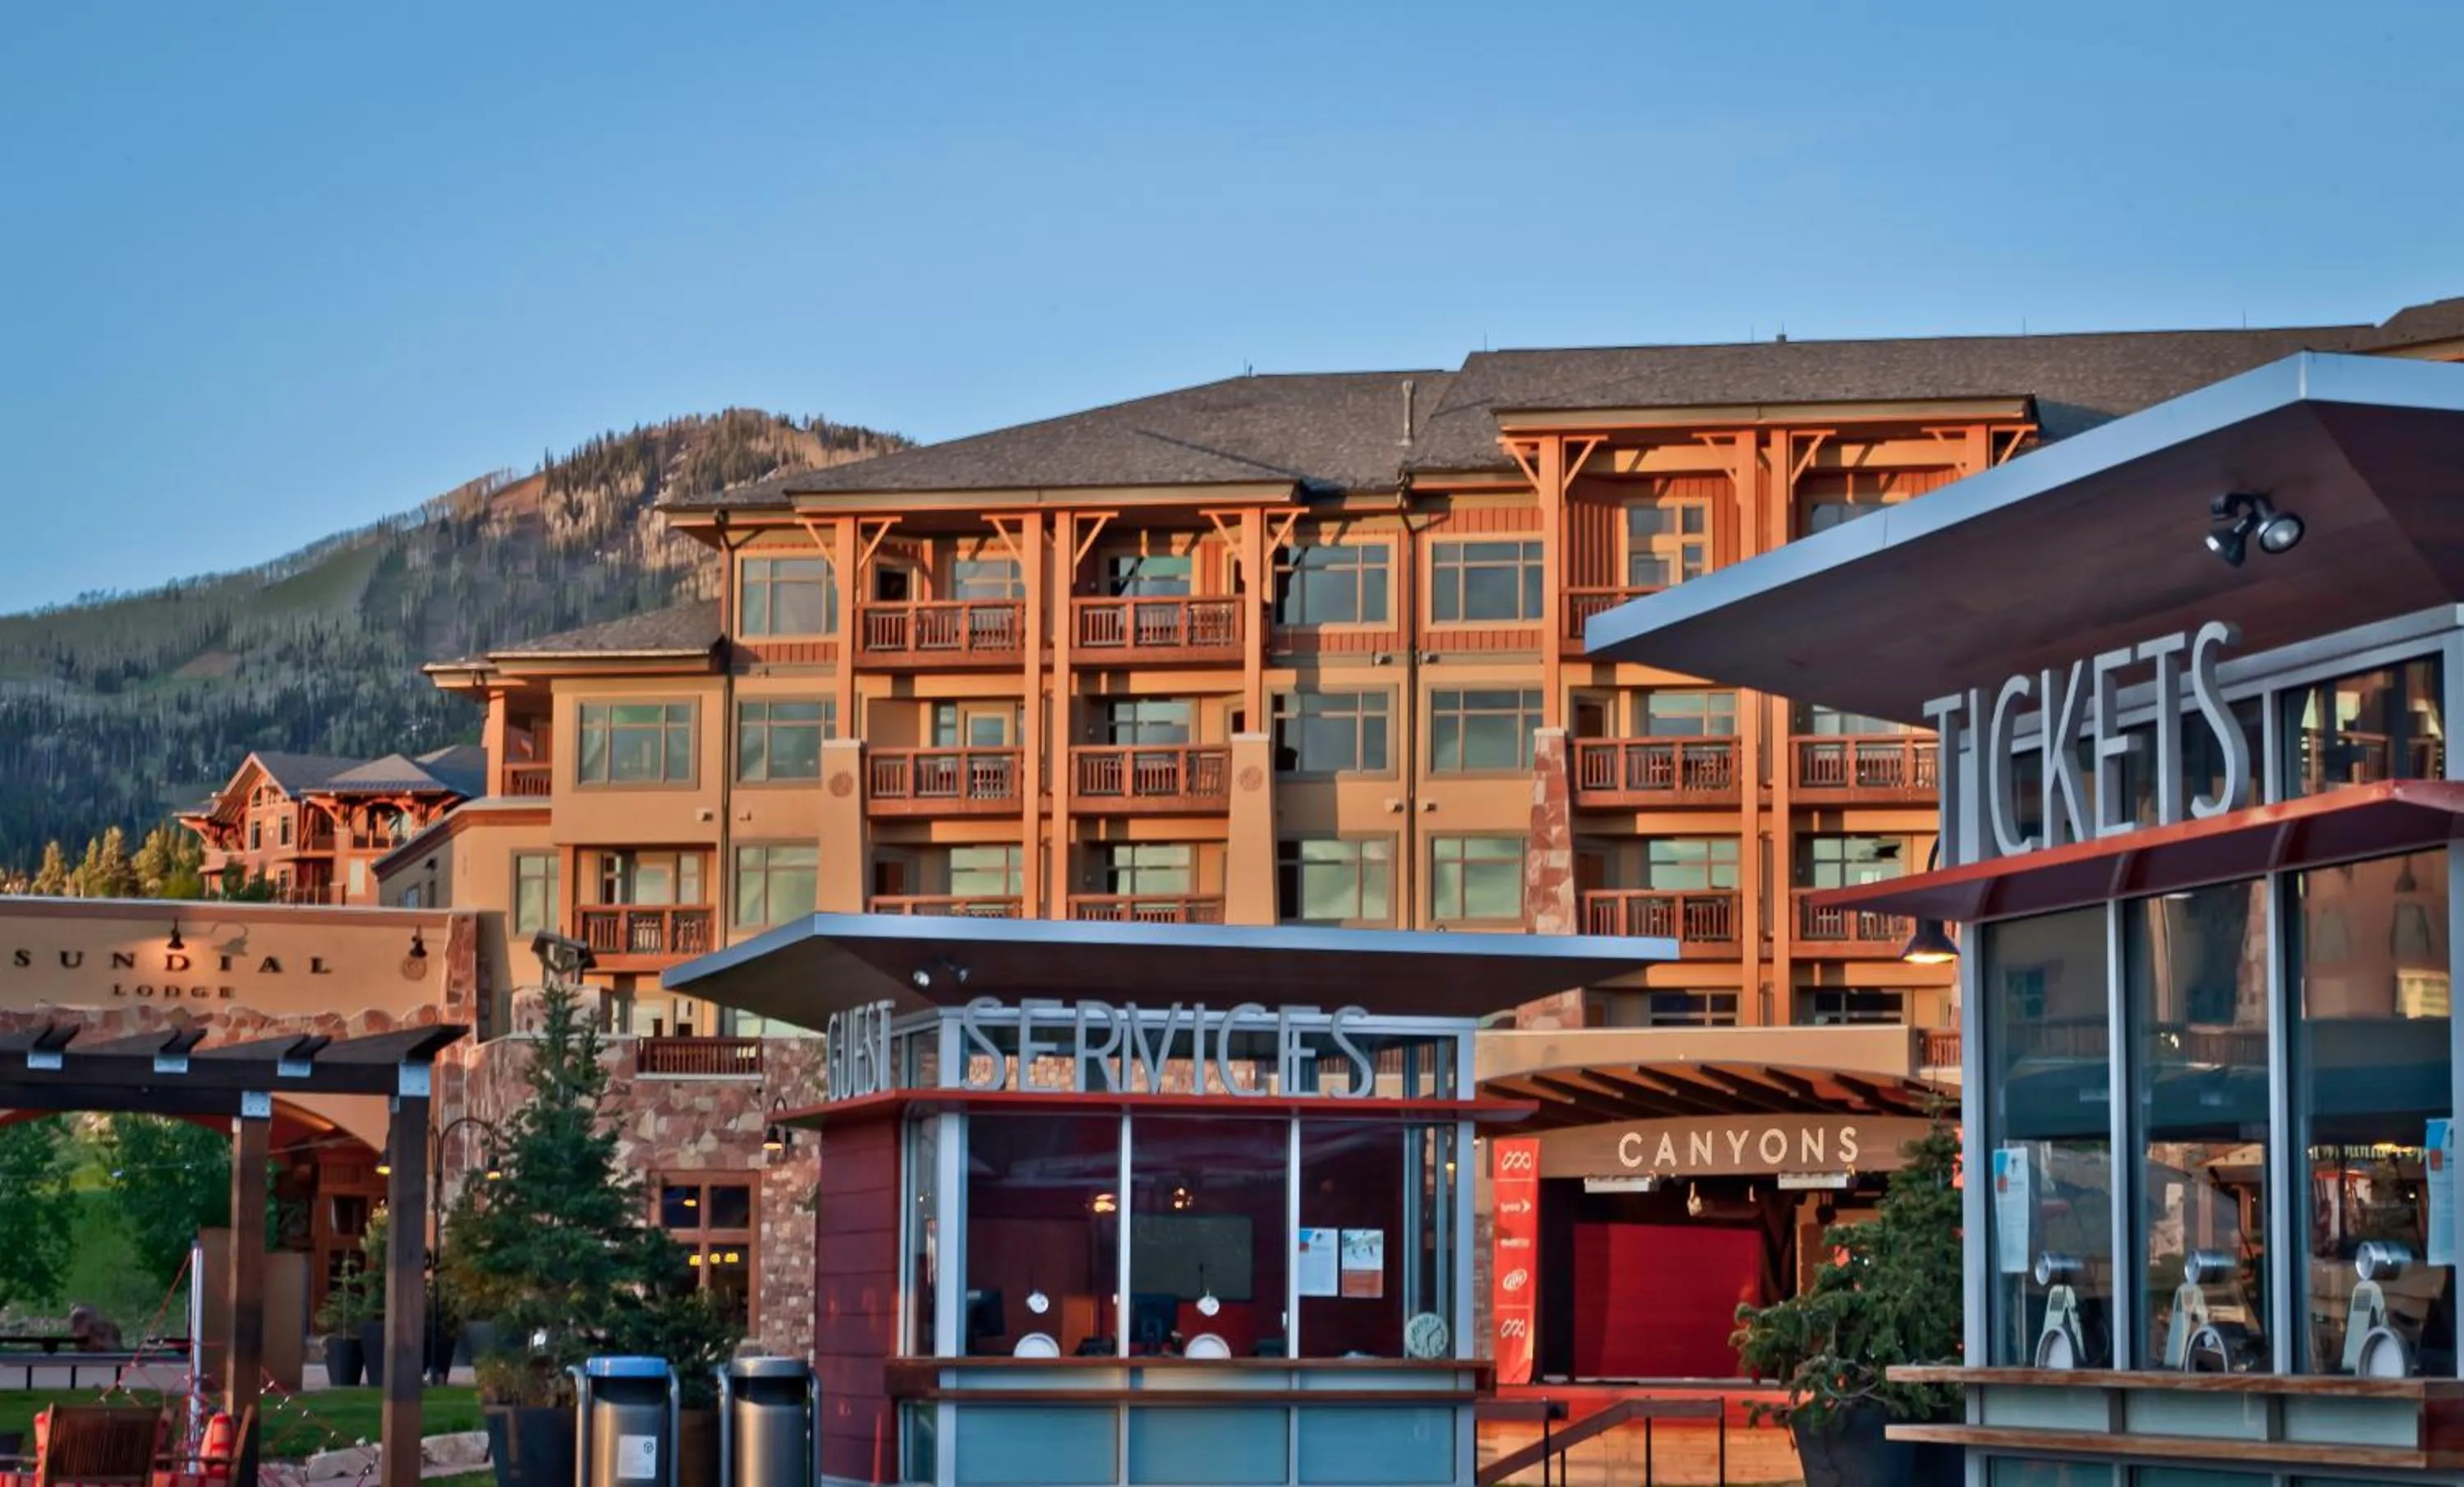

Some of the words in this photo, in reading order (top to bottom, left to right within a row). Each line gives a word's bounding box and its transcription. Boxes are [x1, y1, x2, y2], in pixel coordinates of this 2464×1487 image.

[1923, 620, 2250, 868] TICKETS
[13, 949, 333, 974] SUNDIAL
[113, 983, 235, 998] LODGE
[826, 999, 895, 1101] GUEST
[961, 997, 1374, 1099] SERVICES
[1619, 1126, 1859, 1167] CANYONS
